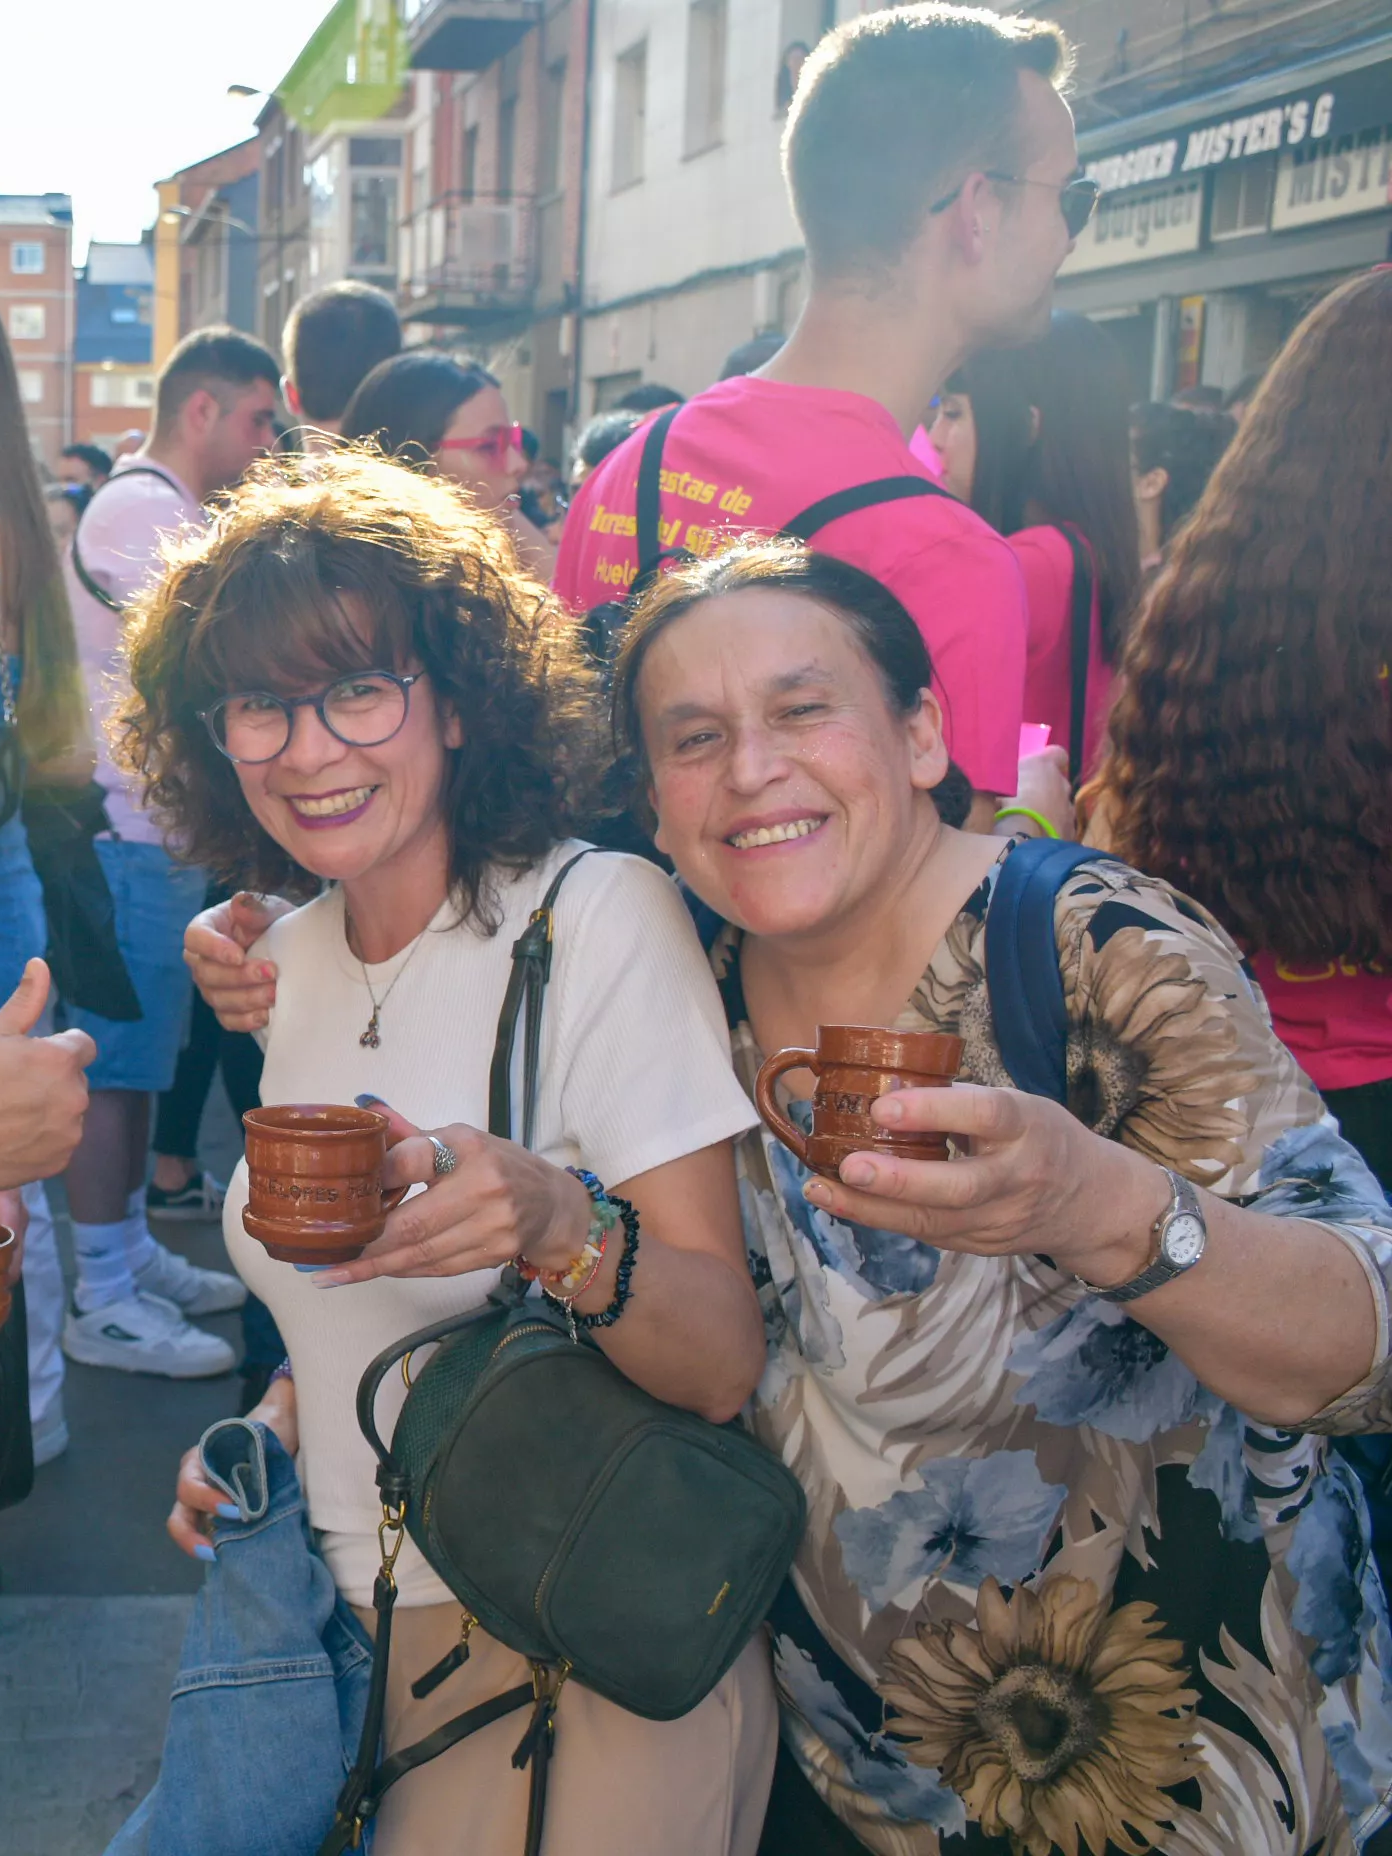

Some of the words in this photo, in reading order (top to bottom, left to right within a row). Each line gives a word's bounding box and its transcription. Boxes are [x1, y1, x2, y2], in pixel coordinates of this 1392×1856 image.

[1181, 100, 1310, 172] MISTER'S
[634, 468, 718, 504] estas
[719, 485, 753, 516] de
